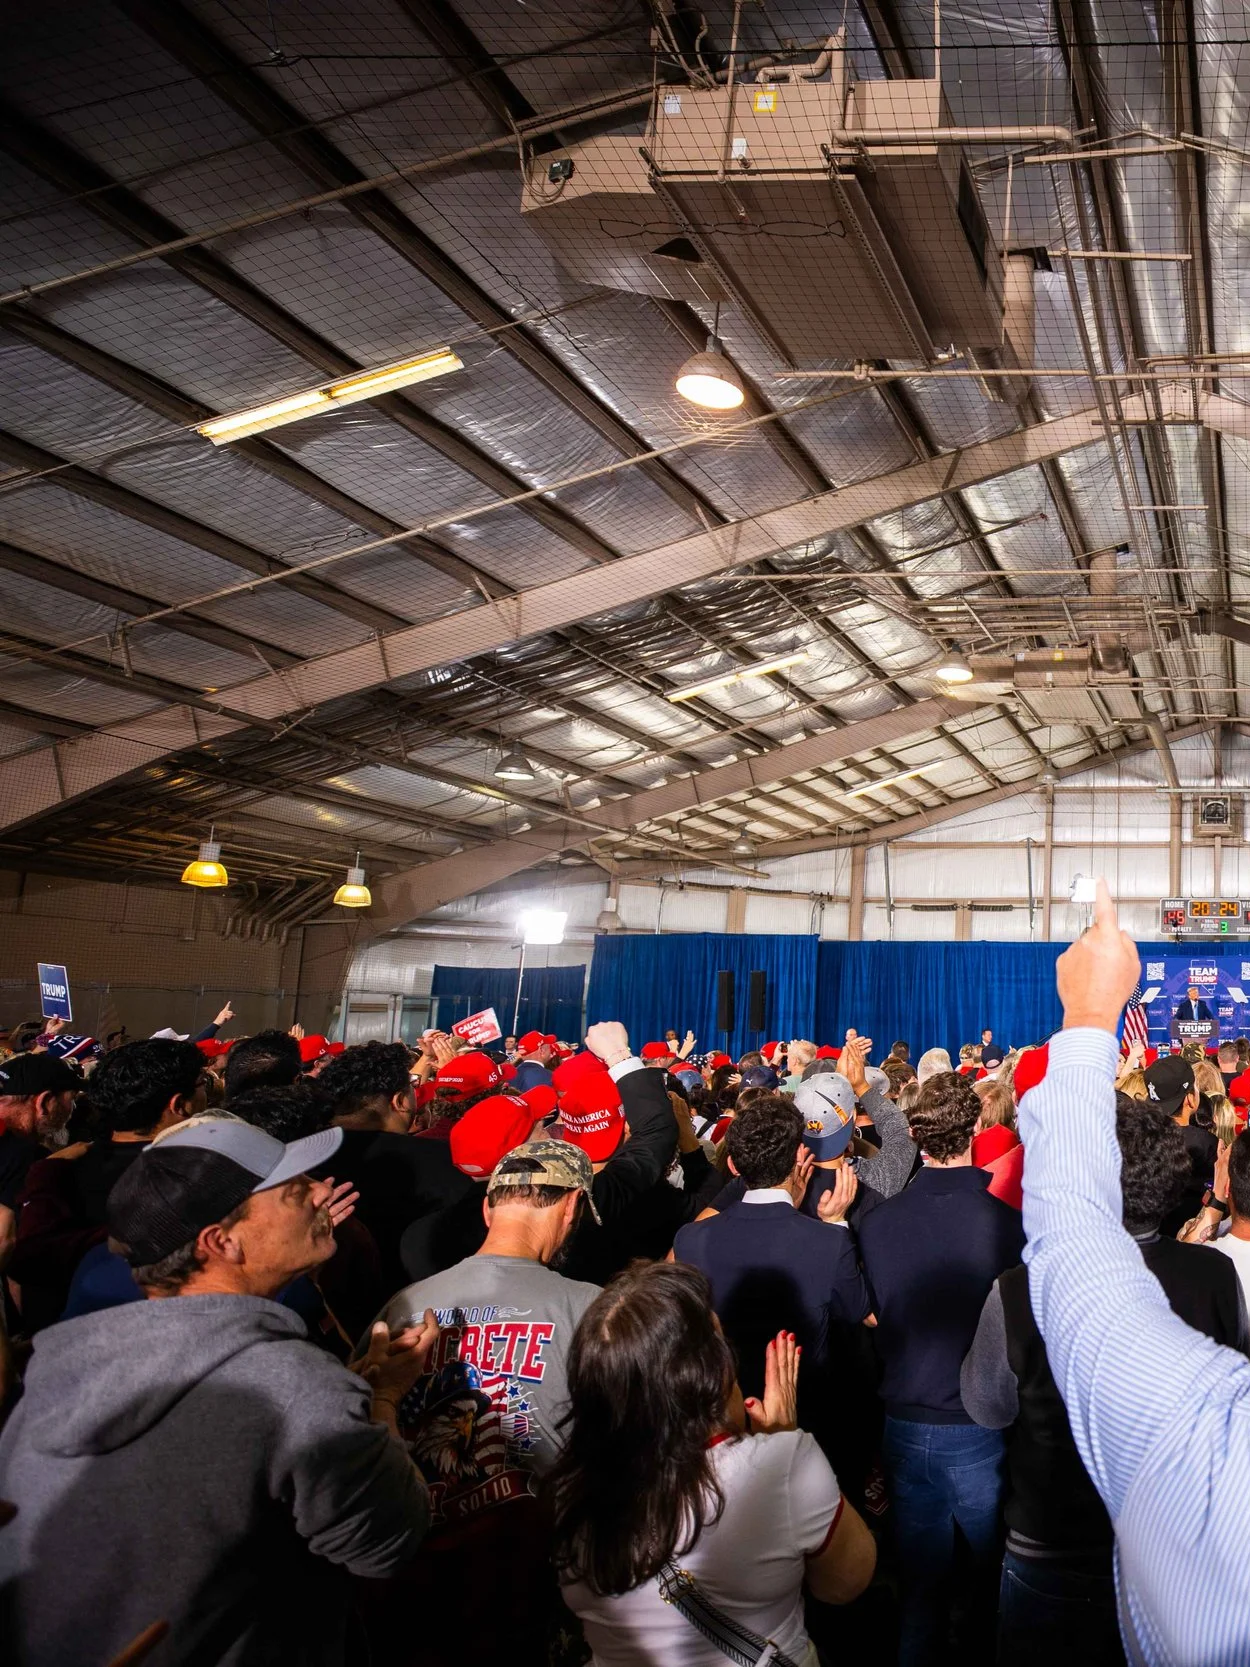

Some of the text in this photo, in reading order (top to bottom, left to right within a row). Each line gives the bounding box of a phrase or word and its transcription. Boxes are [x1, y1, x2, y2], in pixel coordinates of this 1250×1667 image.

[1221, 921, 1228, 933] 3
[1189, 967, 1218, 975] TEAM
[42, 983, 66, 998] TRUMP
[458, 1015, 490, 1034] CAUCU
[468, 1027, 480, 1036] FOR
[1178, 1025, 1212, 1033] TRUMP
[53, 1035, 82, 1050] TR
[468, 1030, 491, 1045] RUMP
[489, 1072, 498, 1083] 45
[574, 1109, 611, 1124] AMERICA
[584, 1120, 609, 1133] AGAIN
[434, 1305, 498, 1325] WORLD OF
[459, 1476, 512, 1517] SOLID
